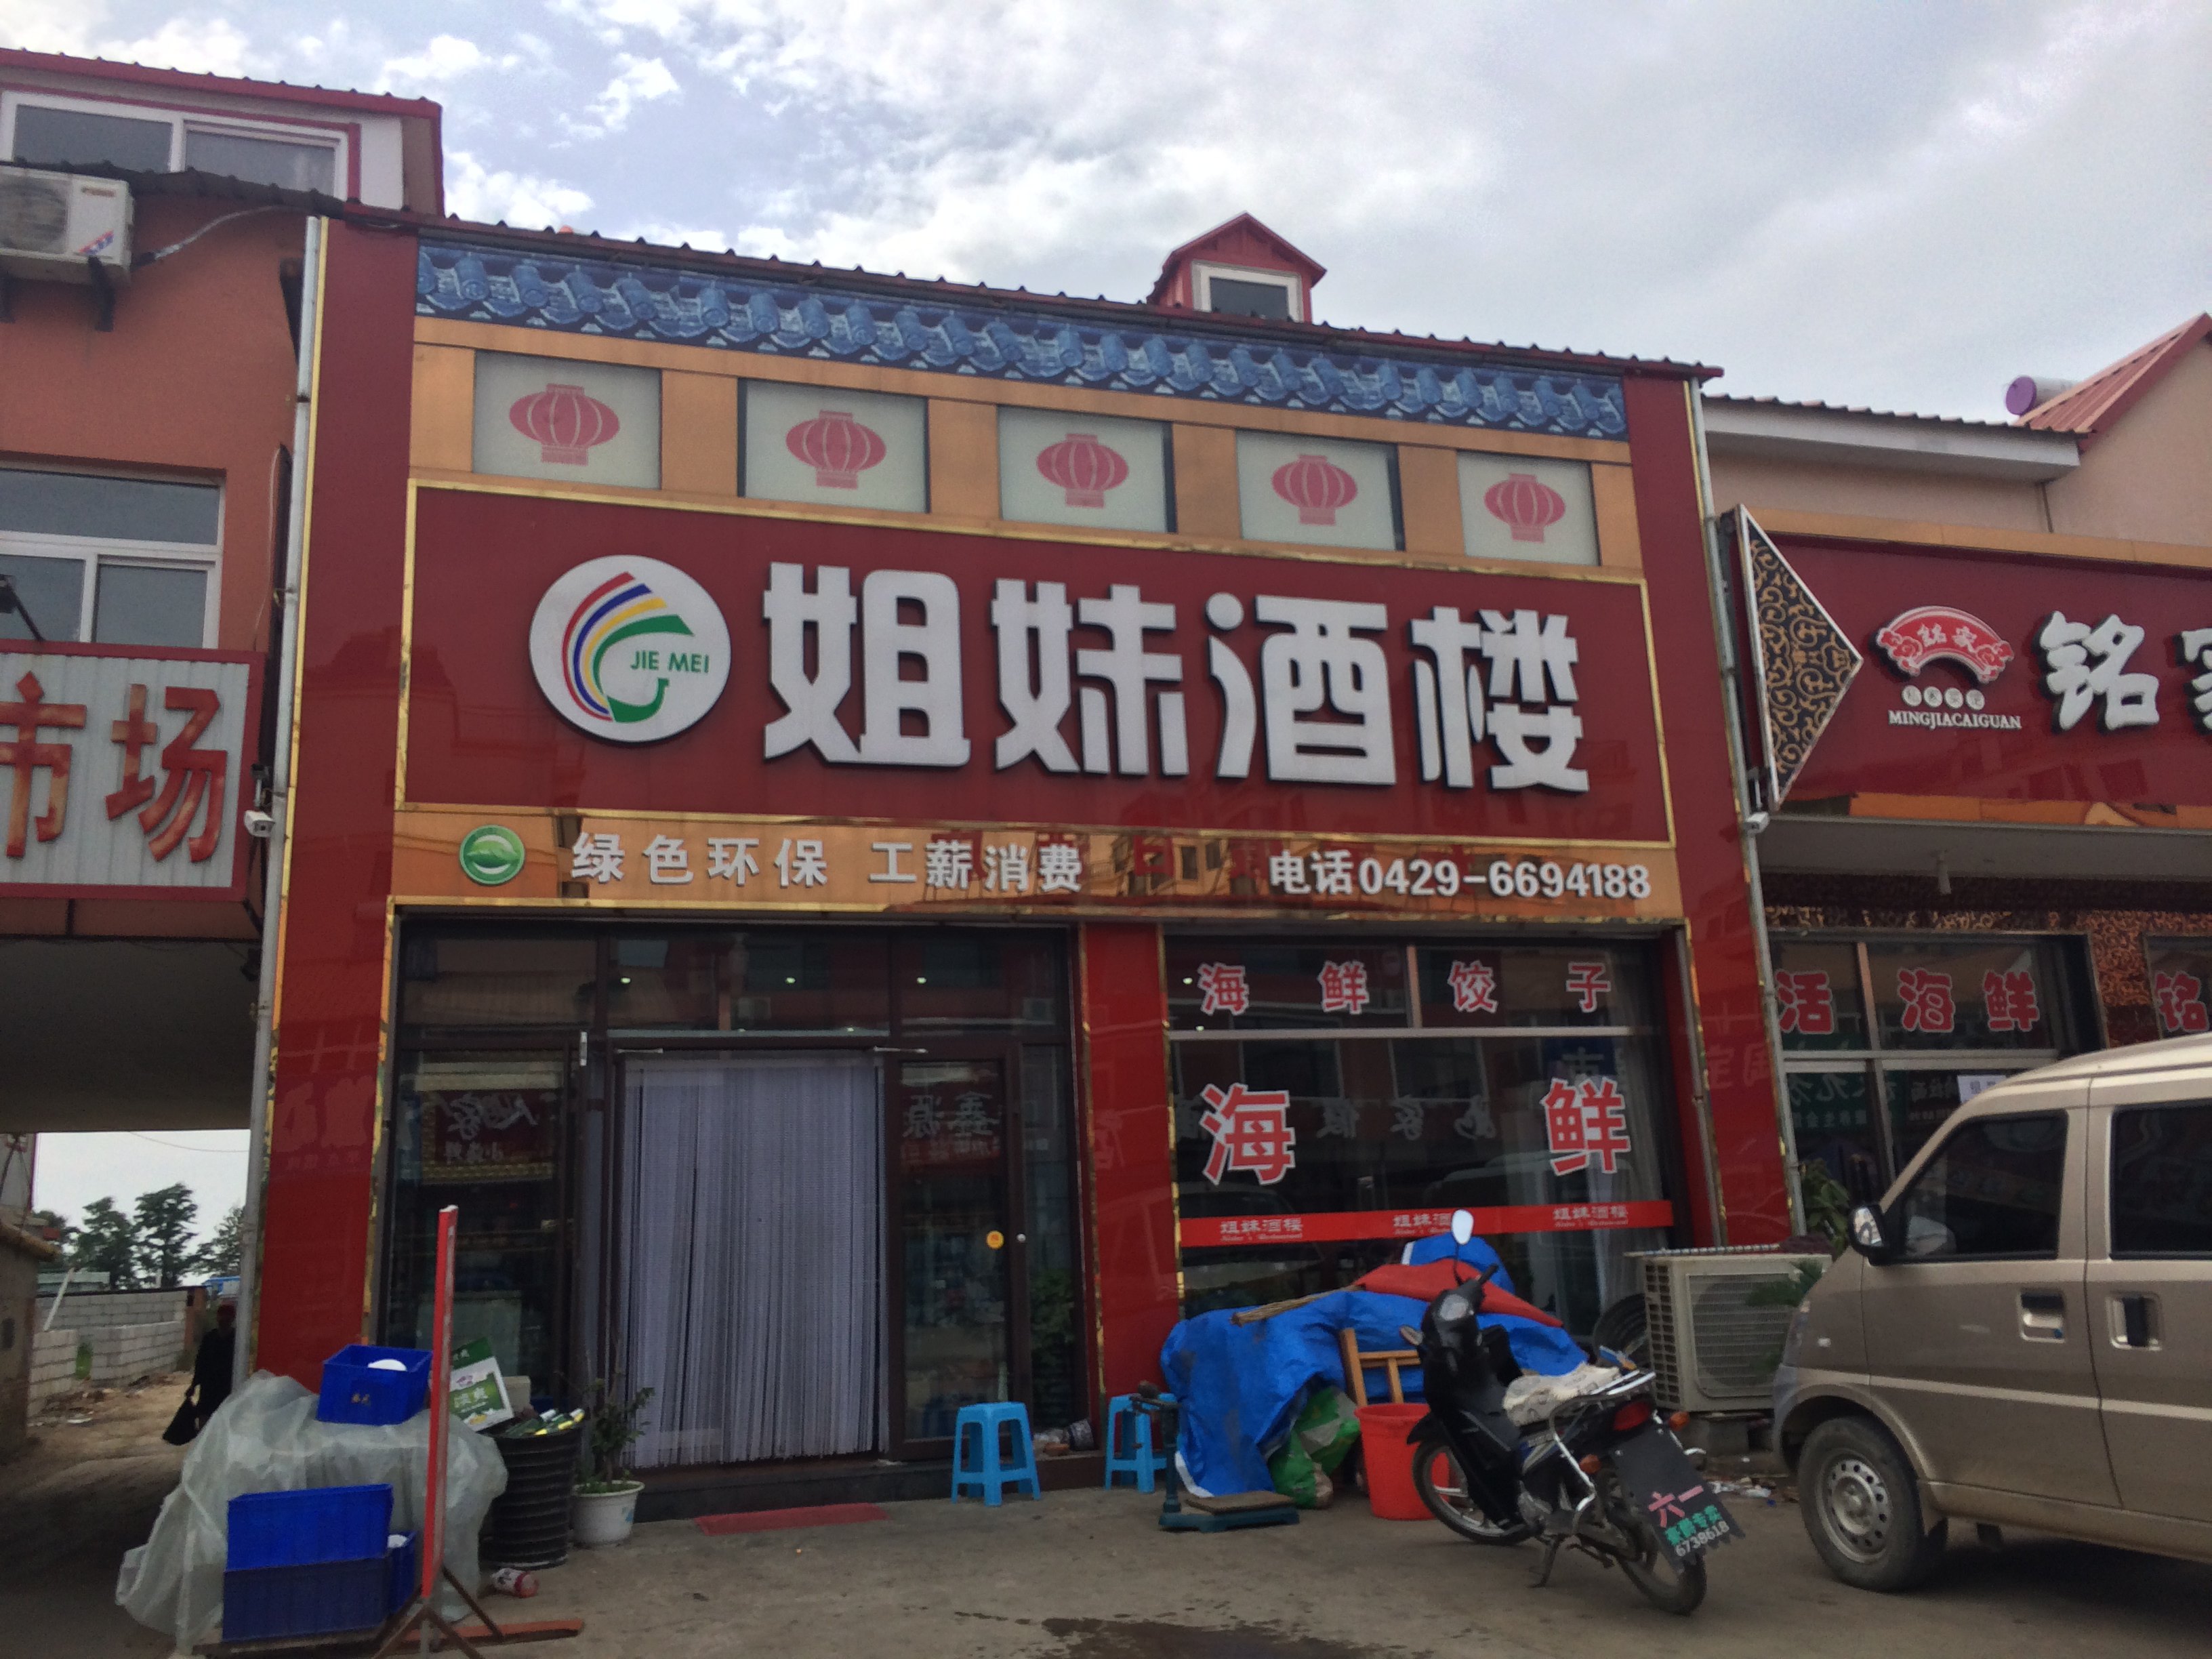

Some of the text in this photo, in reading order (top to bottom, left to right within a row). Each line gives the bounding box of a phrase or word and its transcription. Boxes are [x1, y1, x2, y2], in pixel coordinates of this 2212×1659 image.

[630, 650, 710, 675] JIE MEI
[762, 561, 1590, 794] 姐妹酒楼
[1887, 710, 2022, 731] MINGJIACAIGUAN
[0, 671, 228, 863] 市场
[571, 832, 1083, 893] 绿色环保 工薪消费
[1197, 960, 1612, 1016] 海鲜饺子
[1775, 968, 2040, 1035] 活海鲜
[1199, 1076, 1631, 1185] 海鲜
[1393, 1212, 1452, 1227] 姐妹酒
[1648, 1484, 1704, 1528] 六一
